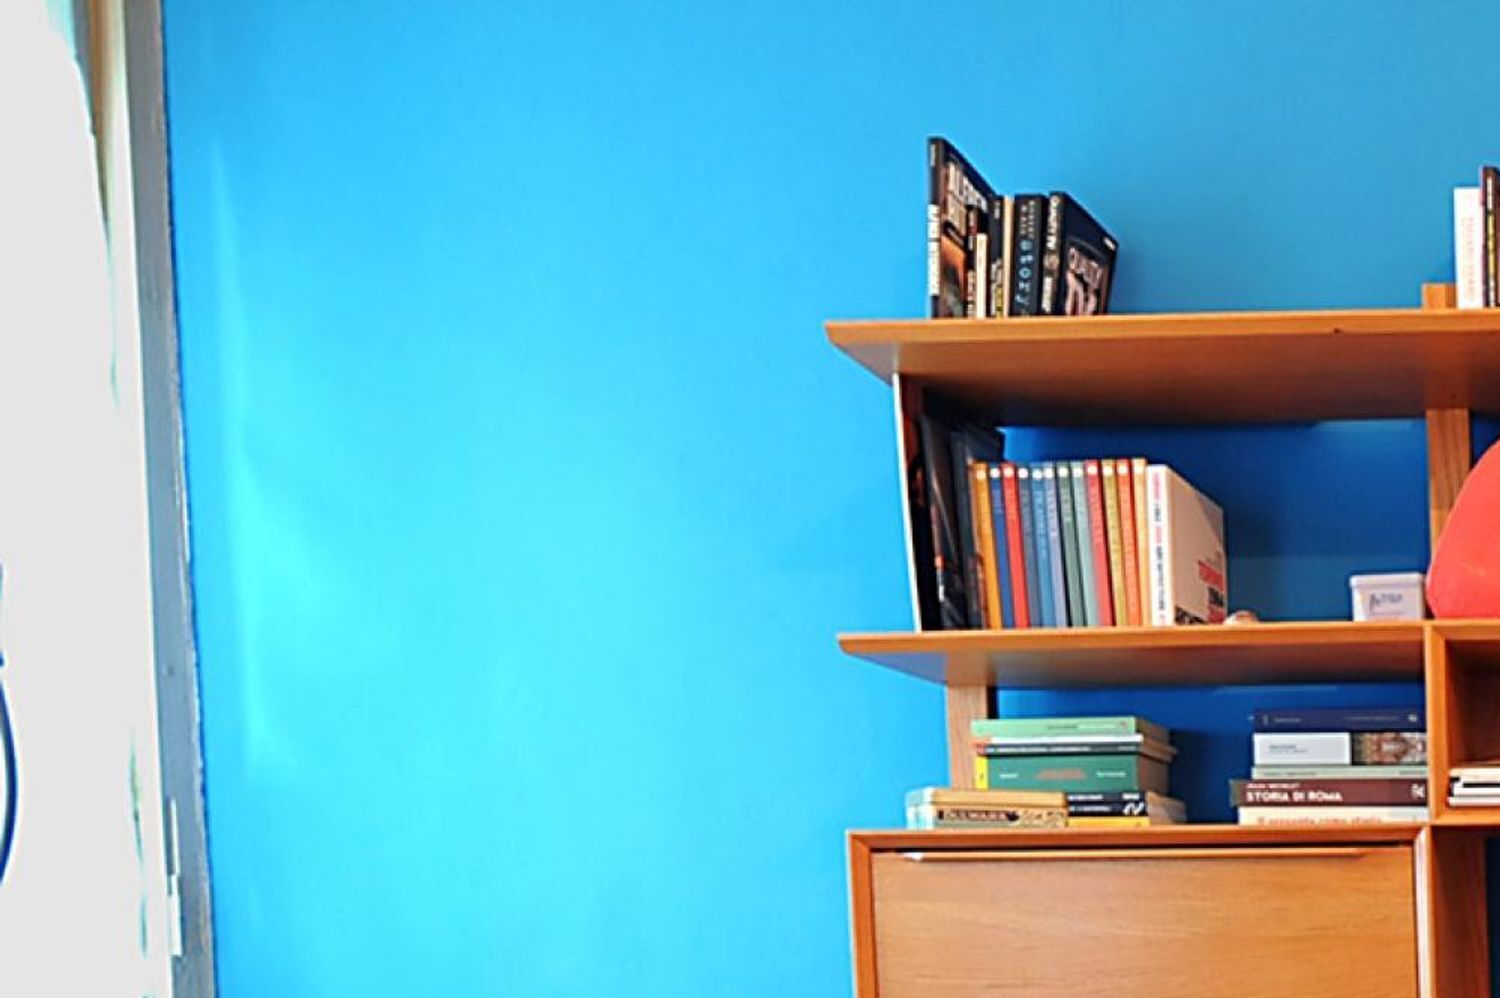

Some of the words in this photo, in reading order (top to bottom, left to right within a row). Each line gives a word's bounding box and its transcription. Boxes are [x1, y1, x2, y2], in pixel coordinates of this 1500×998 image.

[1247, 790, 1289, 802] STORIA
[1293, 790, 1304, 802] DI
[1309, 790, 1344, 802] ROMA
